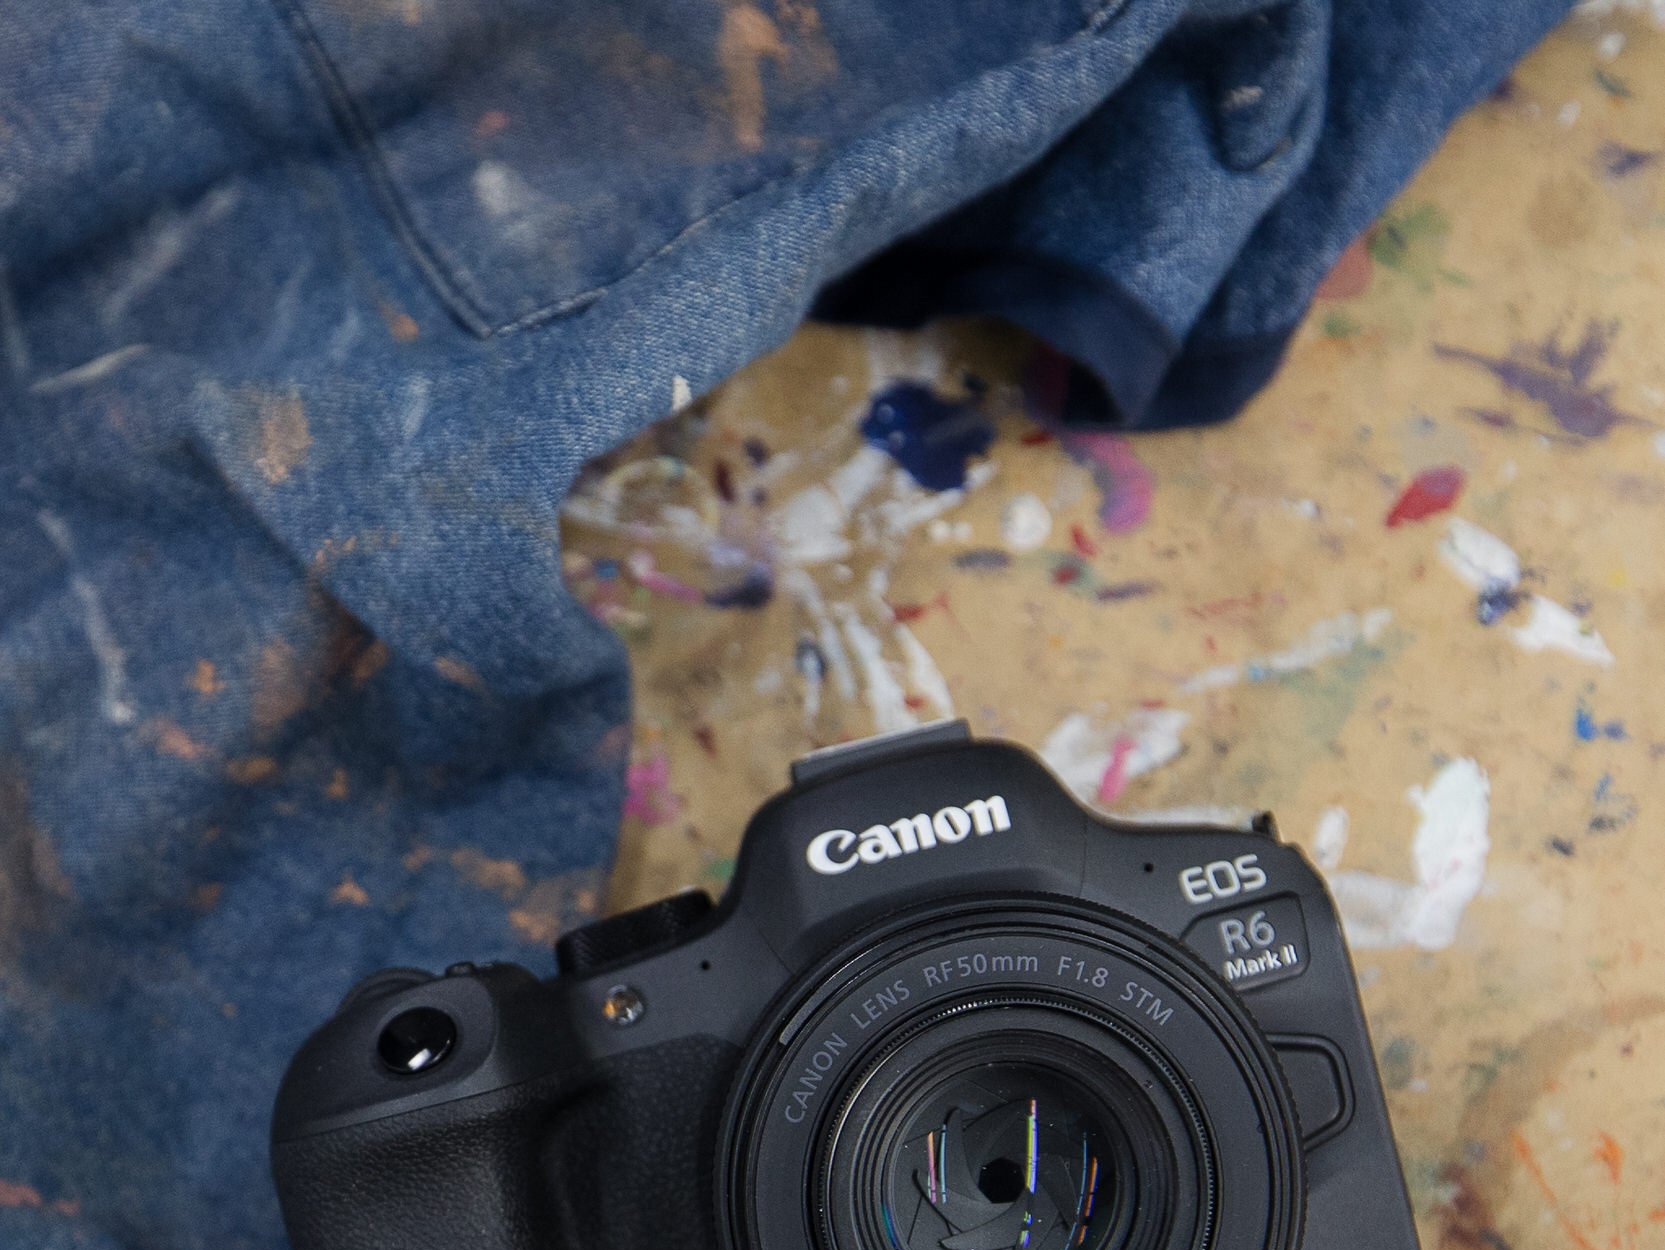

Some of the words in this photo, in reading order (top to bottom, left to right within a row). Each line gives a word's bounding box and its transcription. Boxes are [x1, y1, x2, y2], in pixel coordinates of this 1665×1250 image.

[805, 795, 1012, 875] Canon
[1181, 853, 1267, 904] EOS
[1220, 910, 1275, 955] R6
[1224, 948, 1282, 980] Mark
[785, 1032, 848, 1124] CANON
[850, 979, 910, 1030] LENS
[1057, 955, 1109, 988] F1.8
[1120, 981, 1175, 1026] STM
